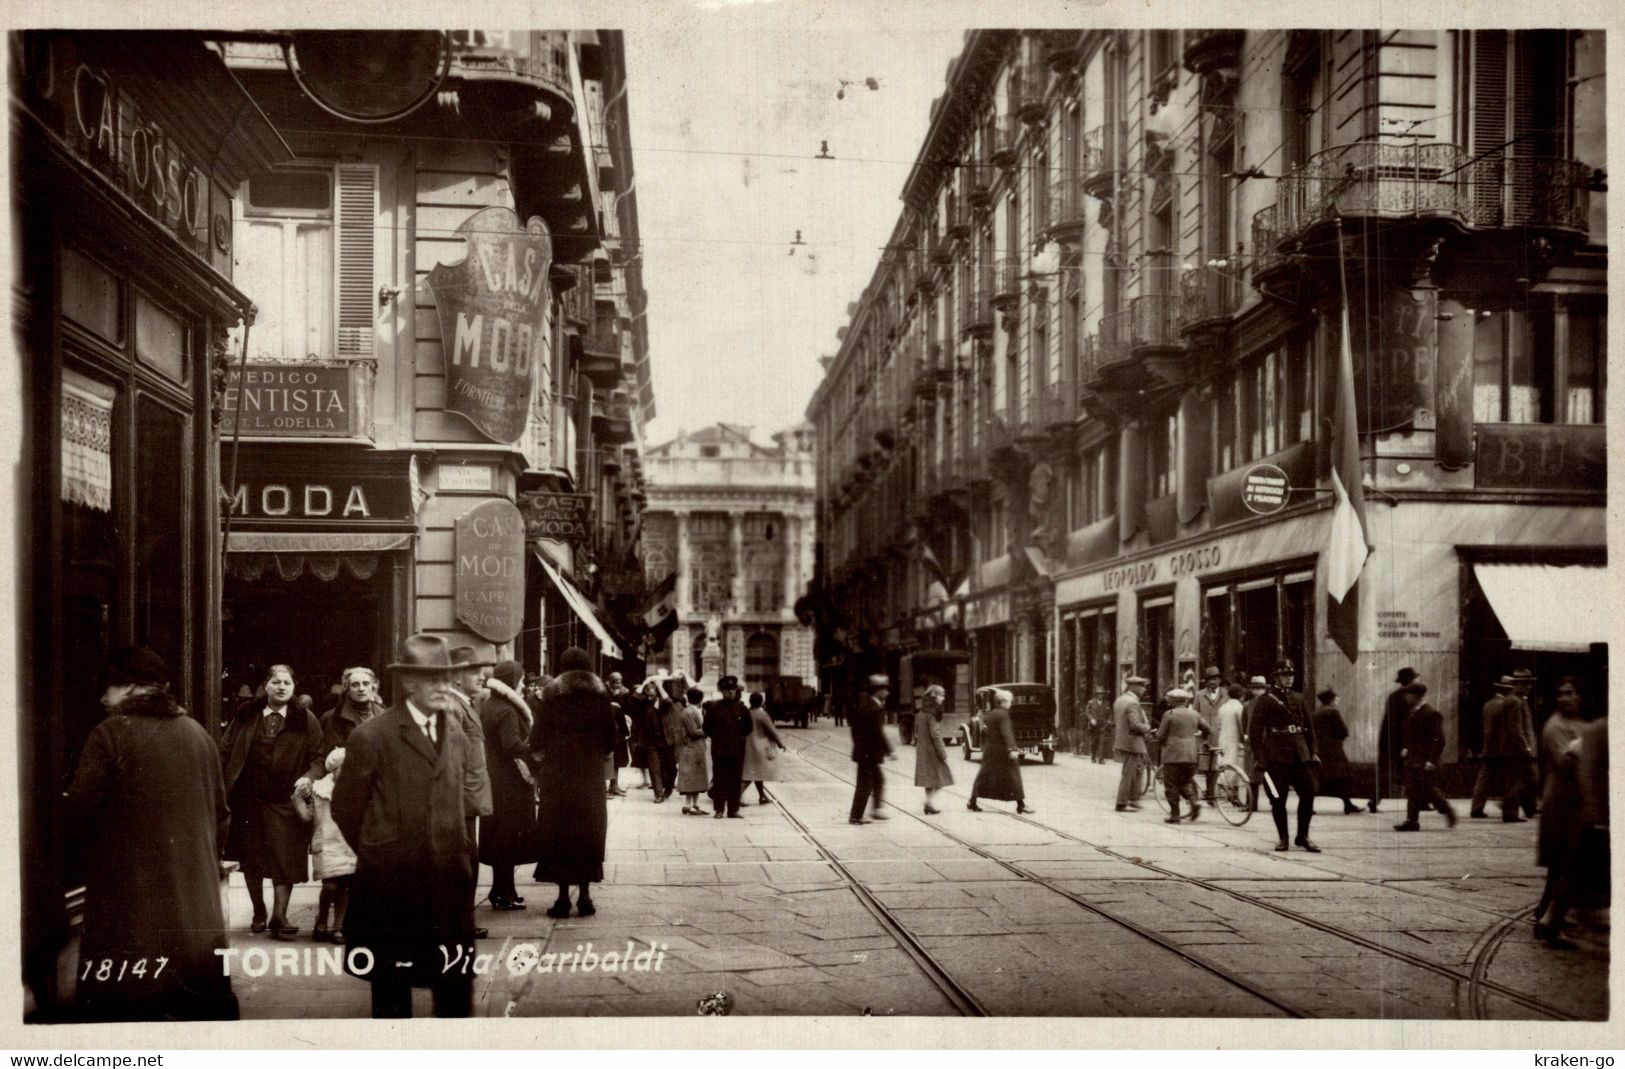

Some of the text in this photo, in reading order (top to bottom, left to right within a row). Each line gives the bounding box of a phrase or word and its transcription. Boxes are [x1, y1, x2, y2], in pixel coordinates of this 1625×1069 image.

[453, 312, 533, 377] MOD
[230, 372, 317, 384] MEDICO
[224, 388, 344, 412] ENTISTA
[273, 417, 335, 428] ODELLA
[219, 484, 370, 516] MODA
[533, 496, 586, 511] CASA
[473, 516, 514, 538] CAS
[529, 520, 586, 536] MODA
[460, 555, 517, 577] MOD
[1103, 546, 1221, 590] LEOPOLDO GROSSO
